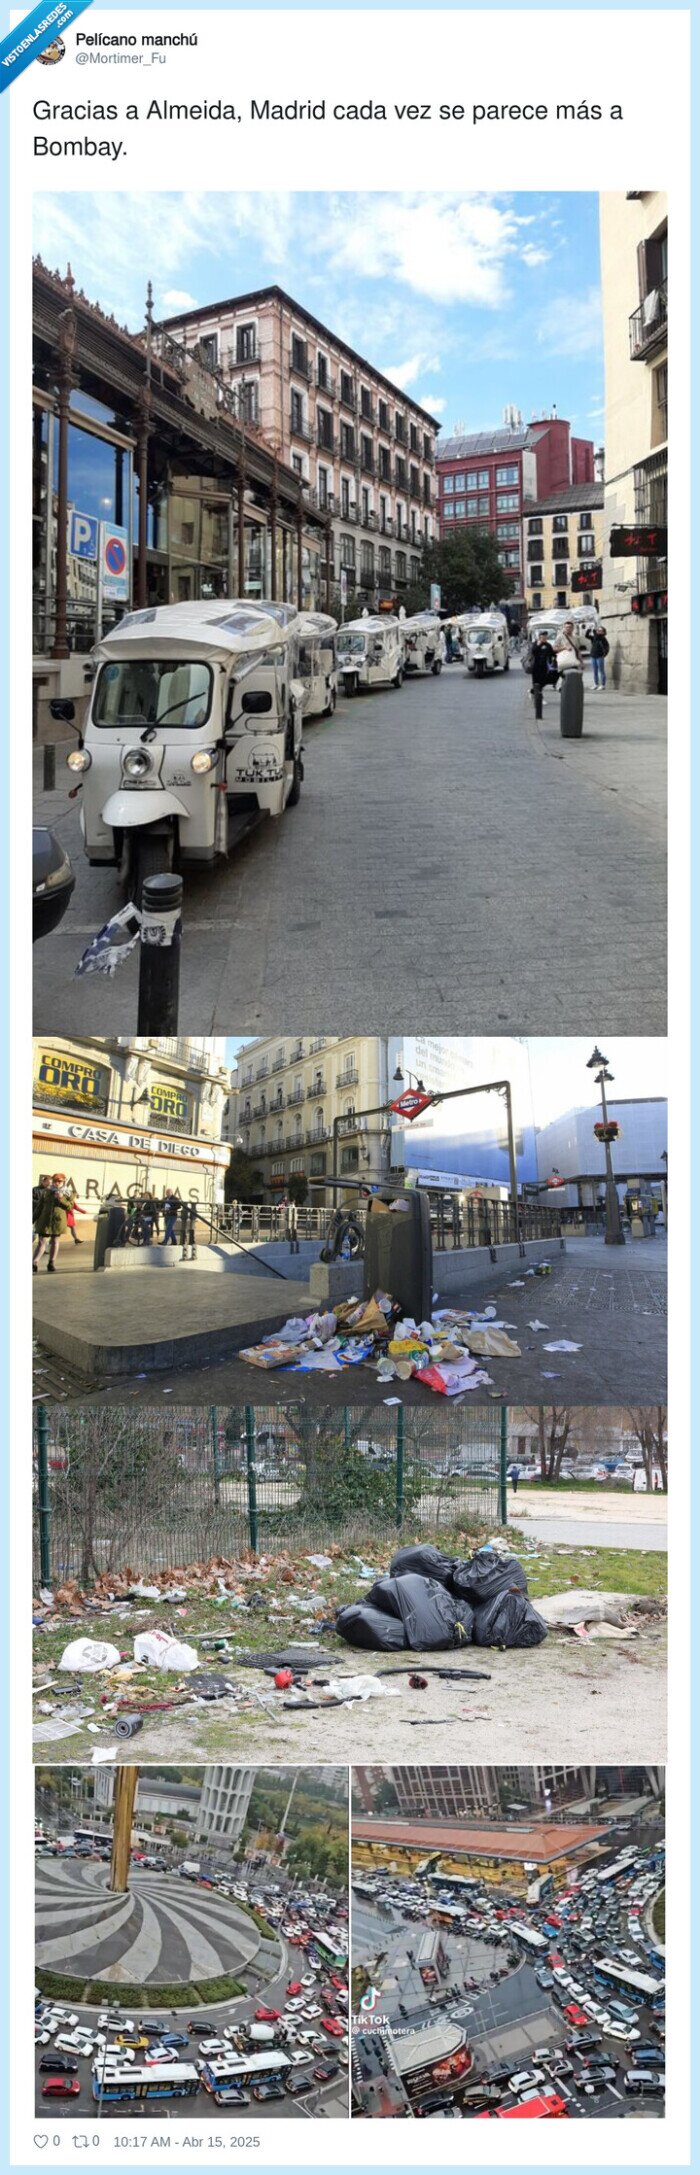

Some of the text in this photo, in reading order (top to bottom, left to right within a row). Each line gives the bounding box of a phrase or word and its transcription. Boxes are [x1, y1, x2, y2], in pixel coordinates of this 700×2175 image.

[74, 517, 91, 551] P
[39, 1065, 100, 1096] ORO
[42, 1054, 101, 1079] COMPRO
[149, 1095, 188, 1119] ORO
[151, 1086, 188, 1102] COMPRO
[68, 1126, 119, 1145] CASA
[129, 1135, 151, 1150] DE
[158, 1140, 200, 1157] DIEGO
